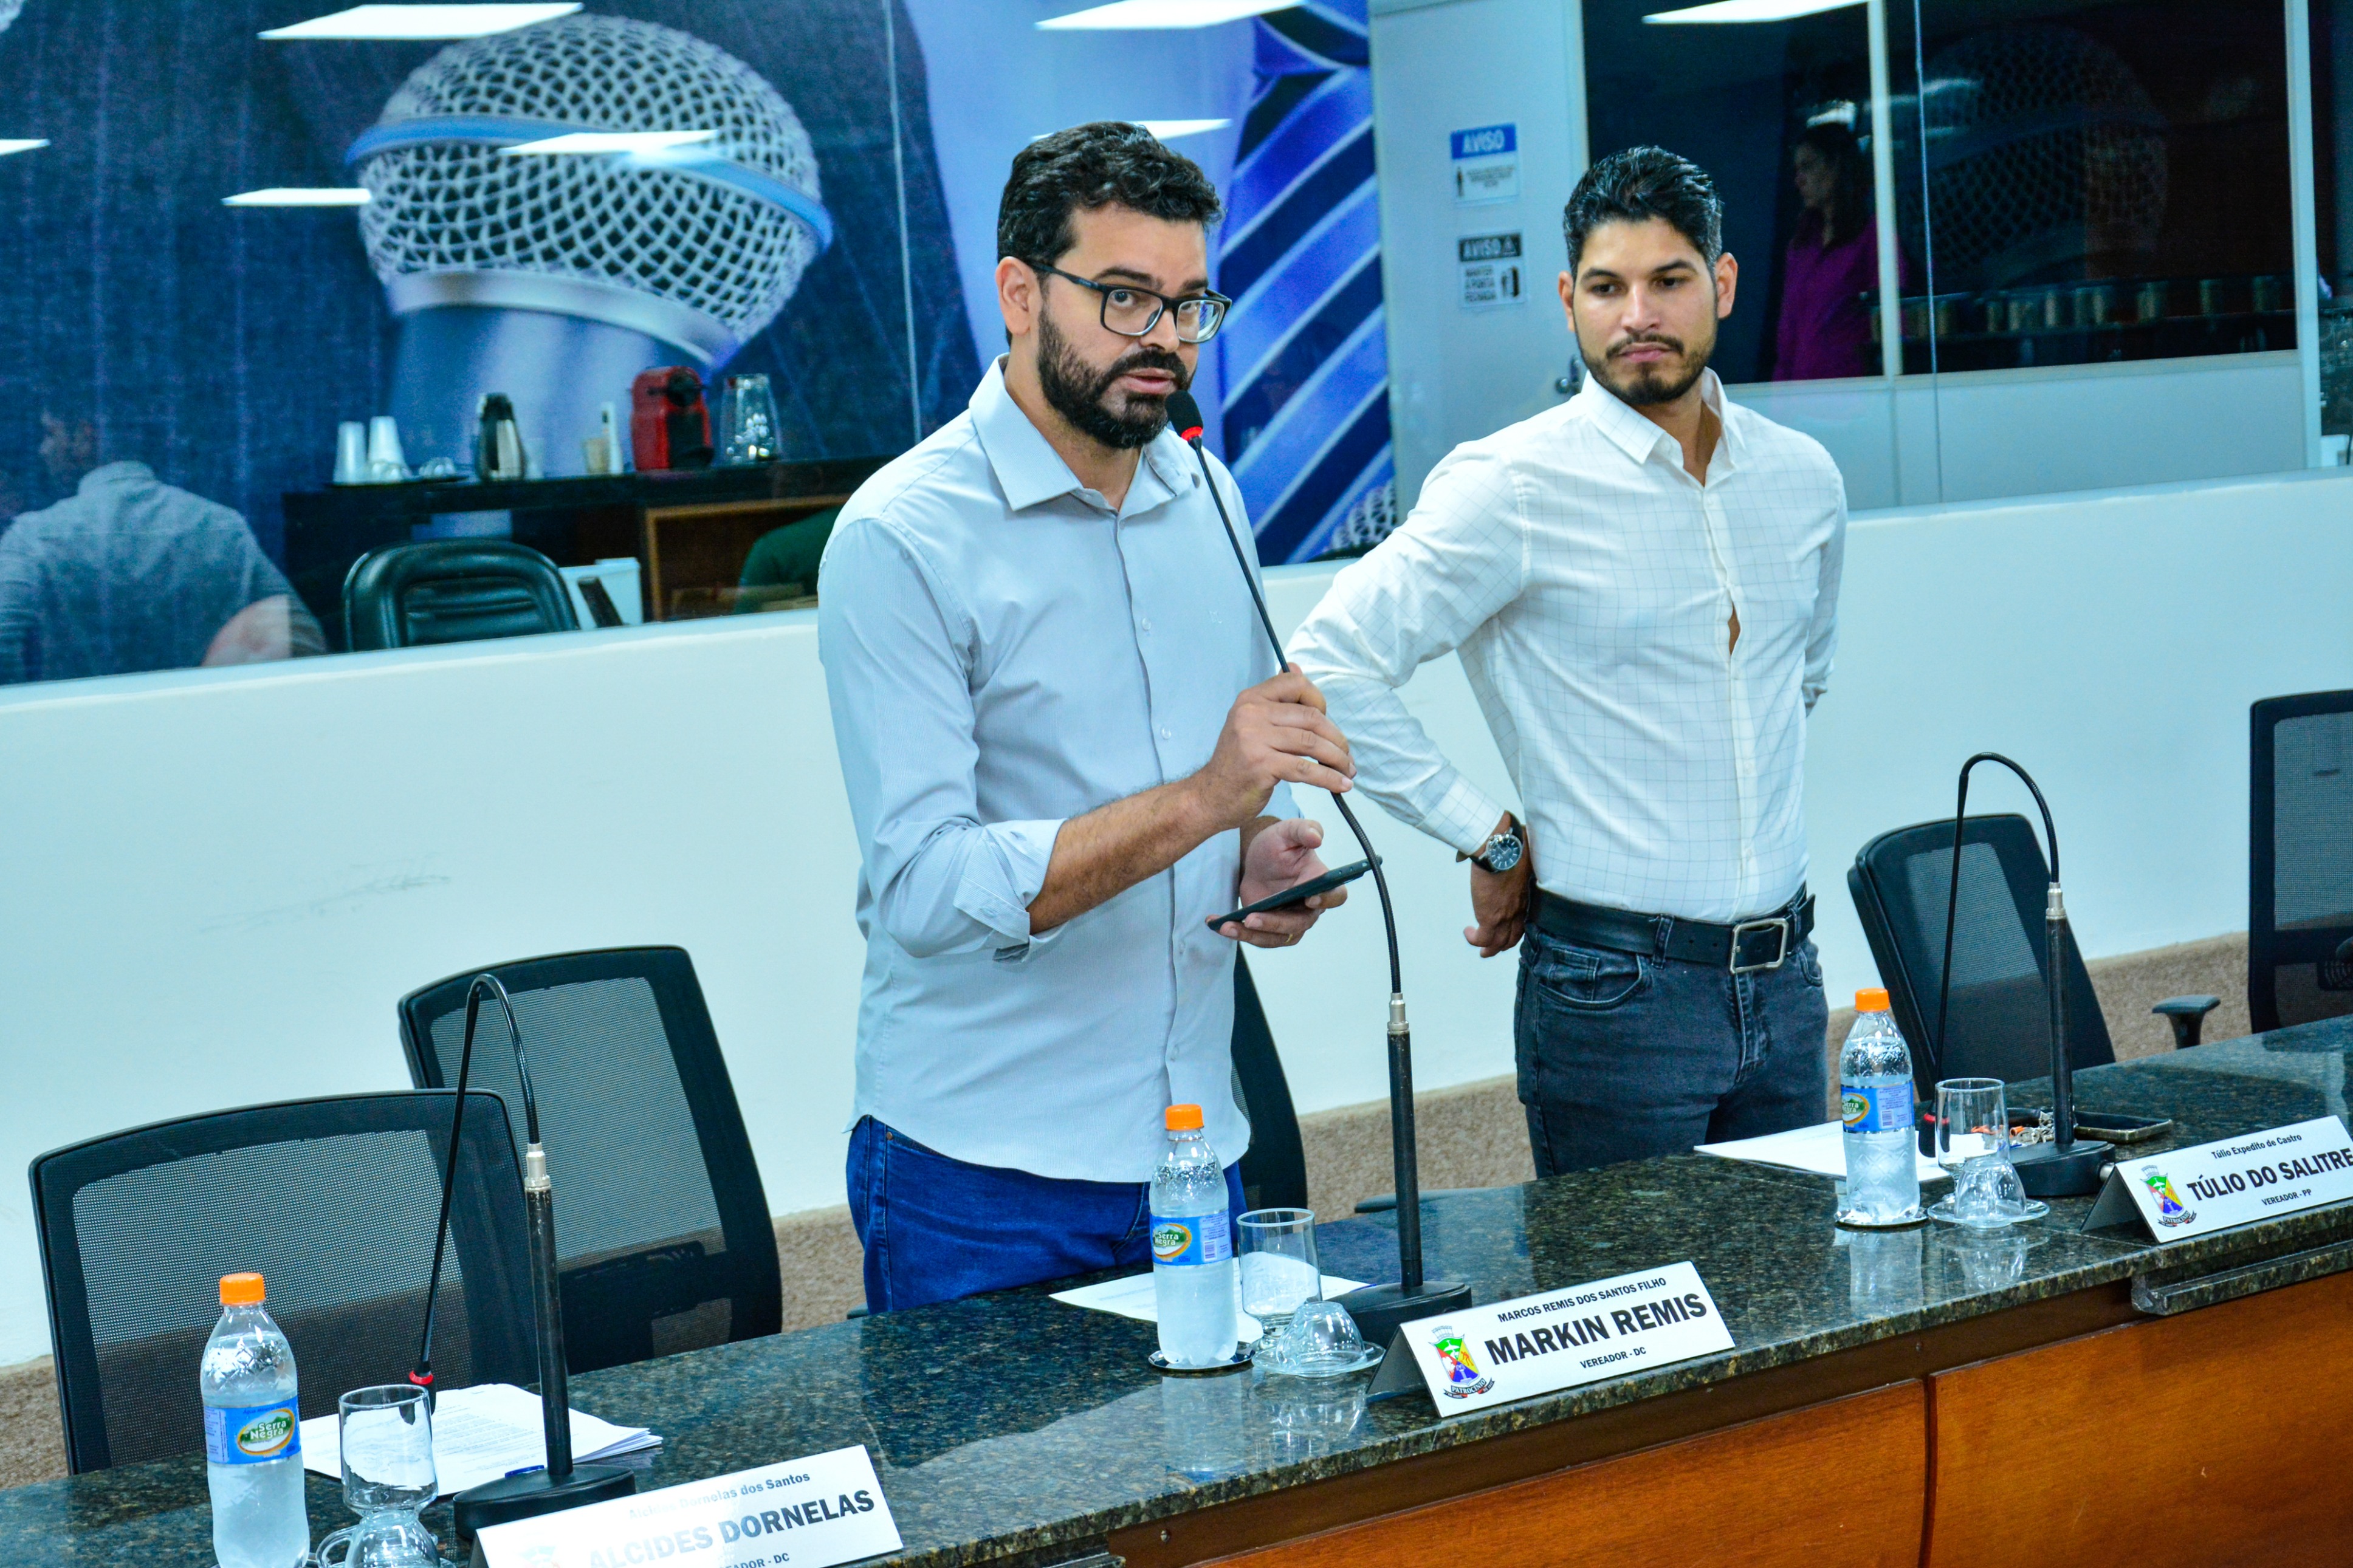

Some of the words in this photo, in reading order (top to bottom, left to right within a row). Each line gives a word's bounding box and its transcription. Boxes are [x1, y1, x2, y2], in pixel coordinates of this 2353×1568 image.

[1463, 128, 1505, 152] AVISO
[1463, 238, 1501, 258] AVISO
[2211, 1149, 2231, 1159] Túlio
[2231, 1142, 2265, 1155] Expedito
[2276, 1134, 2302, 1145] Castro
[2186, 1174, 2246, 1201] TÚLIO
[2245, 1166, 2278, 1188] DO
[2278, 1148, 2353, 1180] SALITRE
[2261, 1191, 2299, 1206] VEREADOR
[2302, 1188, 2312, 1197] PP
[1155, 1238, 1176, 1247] Negra
[1158, 1231, 1179, 1240] Serra
[1497, 1306, 1542, 1323] MARCOS
[1542, 1298, 1575, 1312] REMIS
[1576, 1293, 1598, 1306] DOS
[1599, 1284, 1637, 1299] SANTOS
[1637, 1278, 1666, 1291] FILHO
[1484, 1315, 1610, 1366] MARKIN
[1610, 1293, 1707, 1335] REMIS
[1580, 1351, 1629, 1369] VEREADOR
[1633, 1347, 1646, 1357] DC
[250, 1428, 284, 1439] Negra
[258, 1420, 286, 1432] Serra
[679, 1489, 737, 1508] Dornelas
[740, 1483, 764, 1495] dos
[765, 1473, 810, 1490] Santos
[590, 1526, 713, 1568] ALCIDES
[718, 1490, 874, 1544] DORNELAS
[773, 1553, 789, 1564] DC
